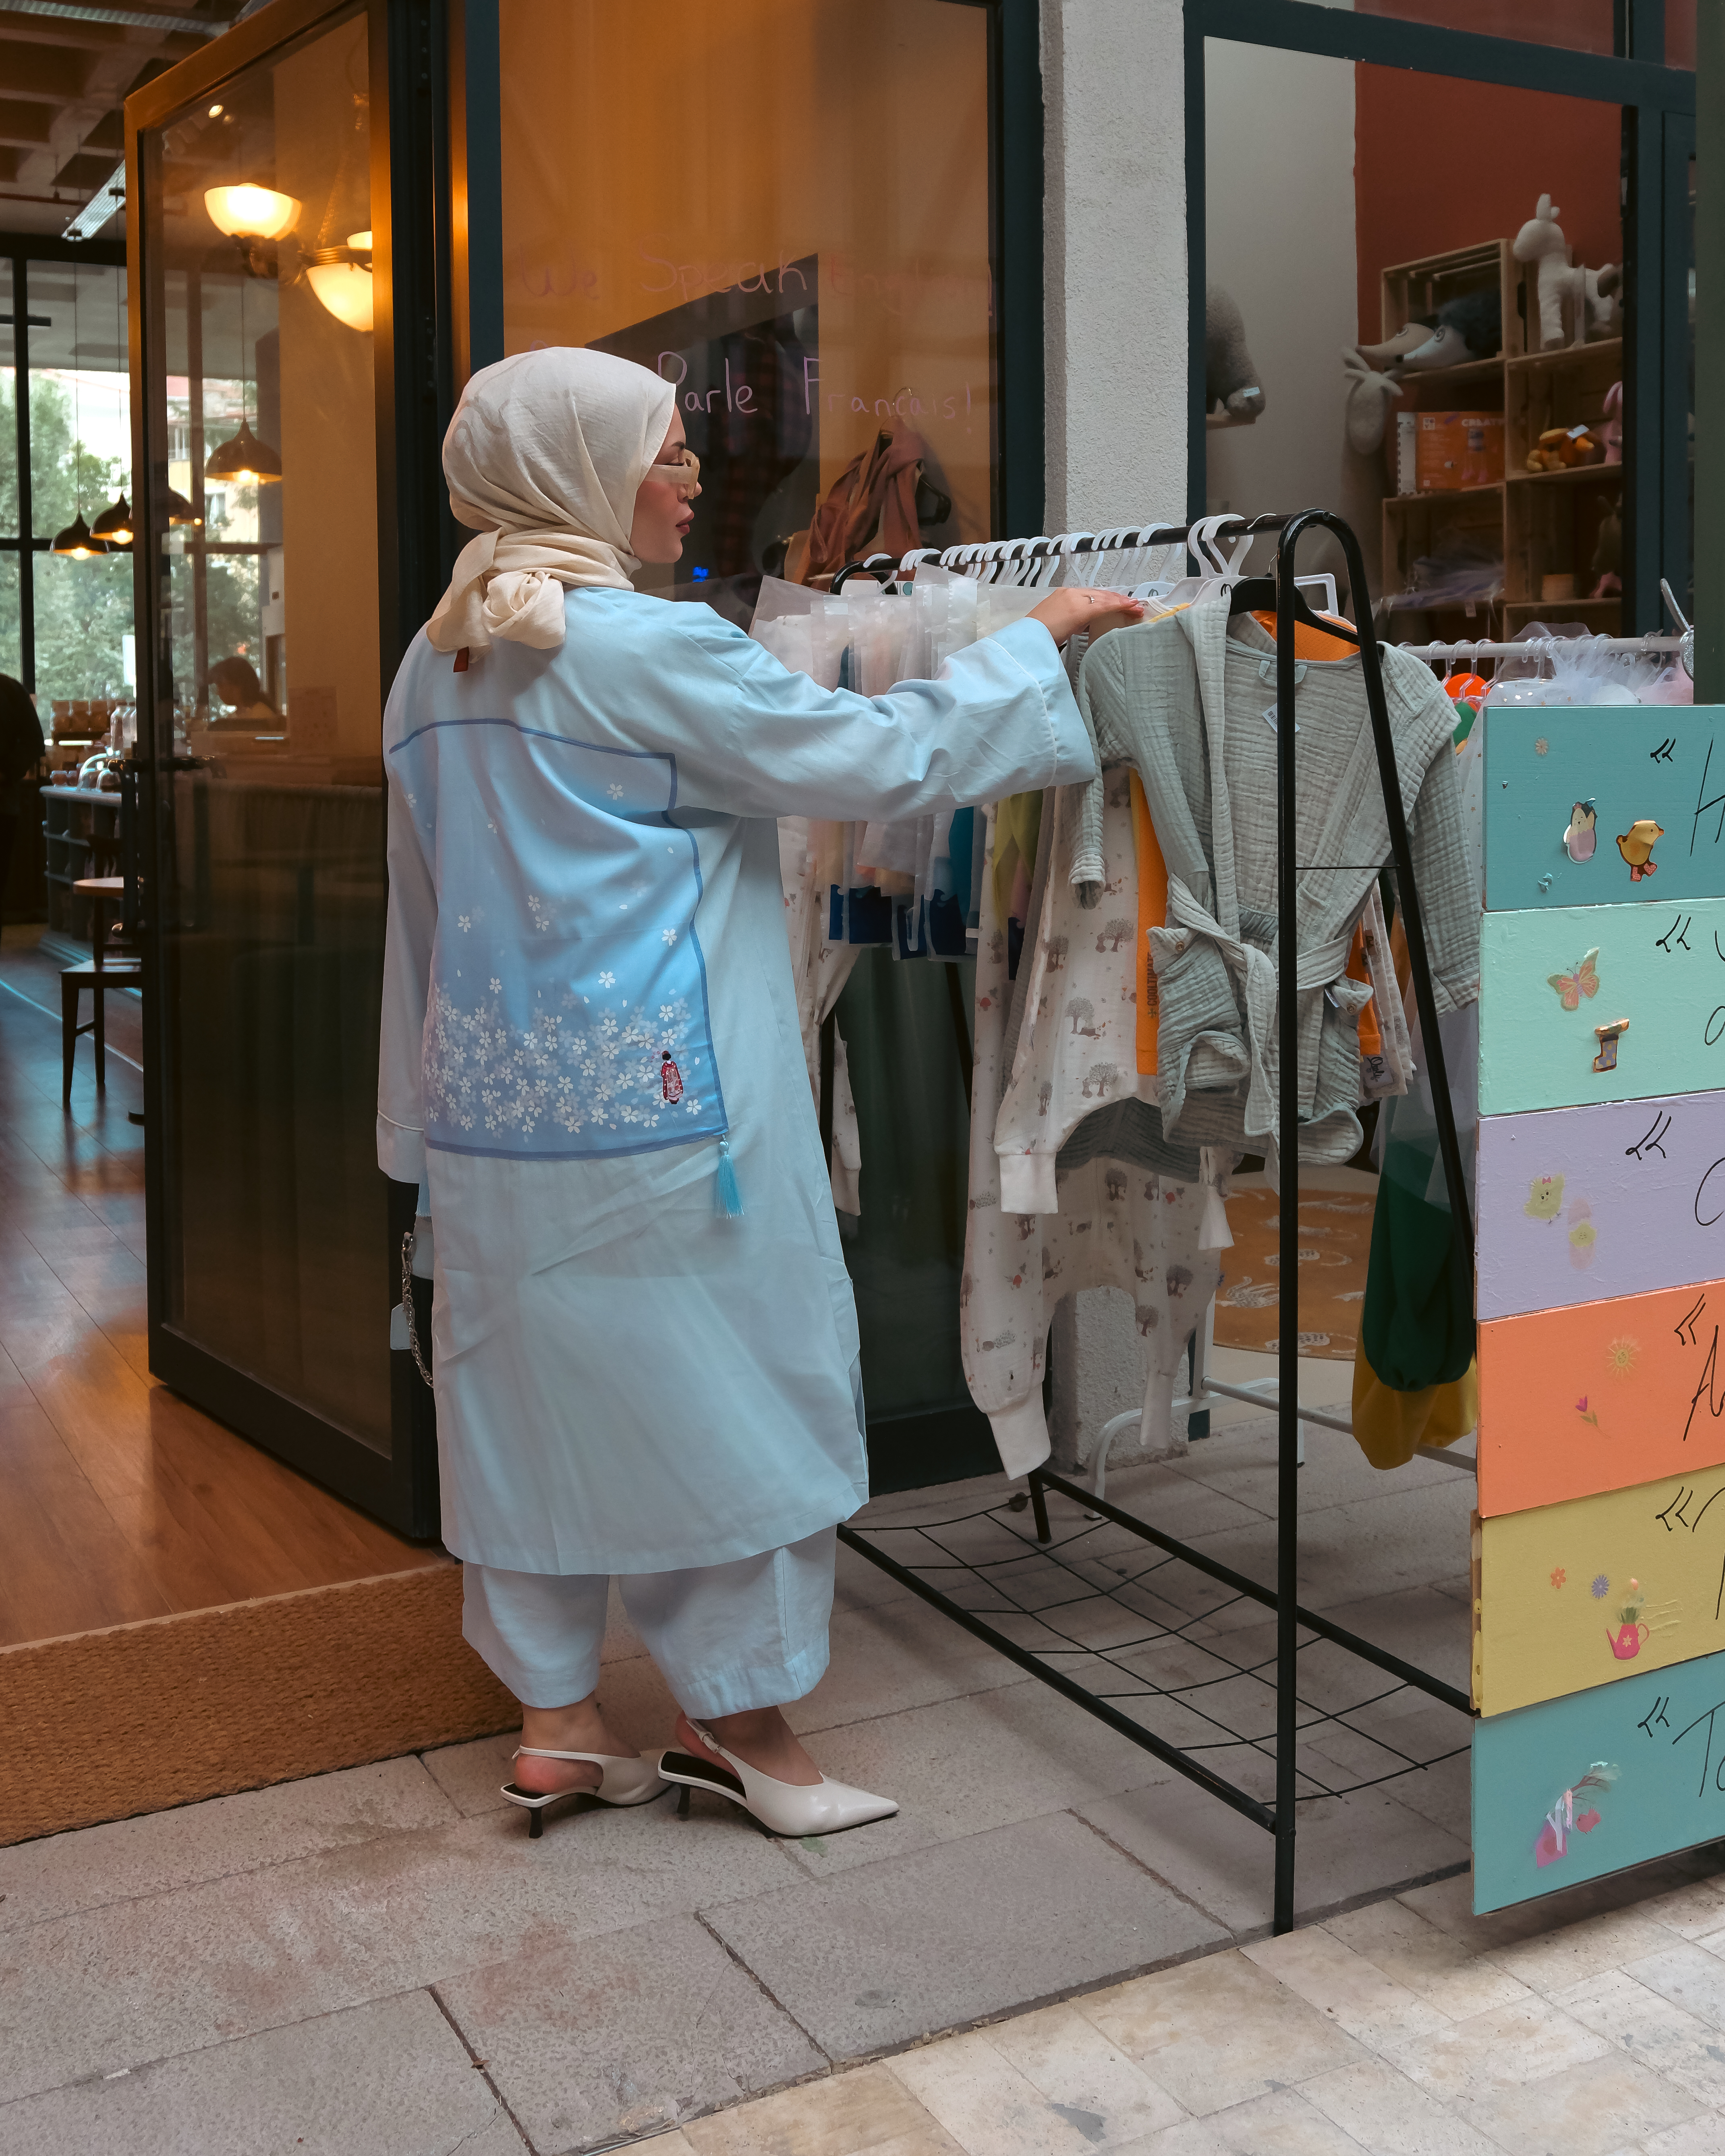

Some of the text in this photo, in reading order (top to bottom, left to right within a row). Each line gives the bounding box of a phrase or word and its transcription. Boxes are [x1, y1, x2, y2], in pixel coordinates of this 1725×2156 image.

[518, 239, 600, 301] We
[638, 232, 809, 302] Speak
[657, 350, 758, 414] Parle
